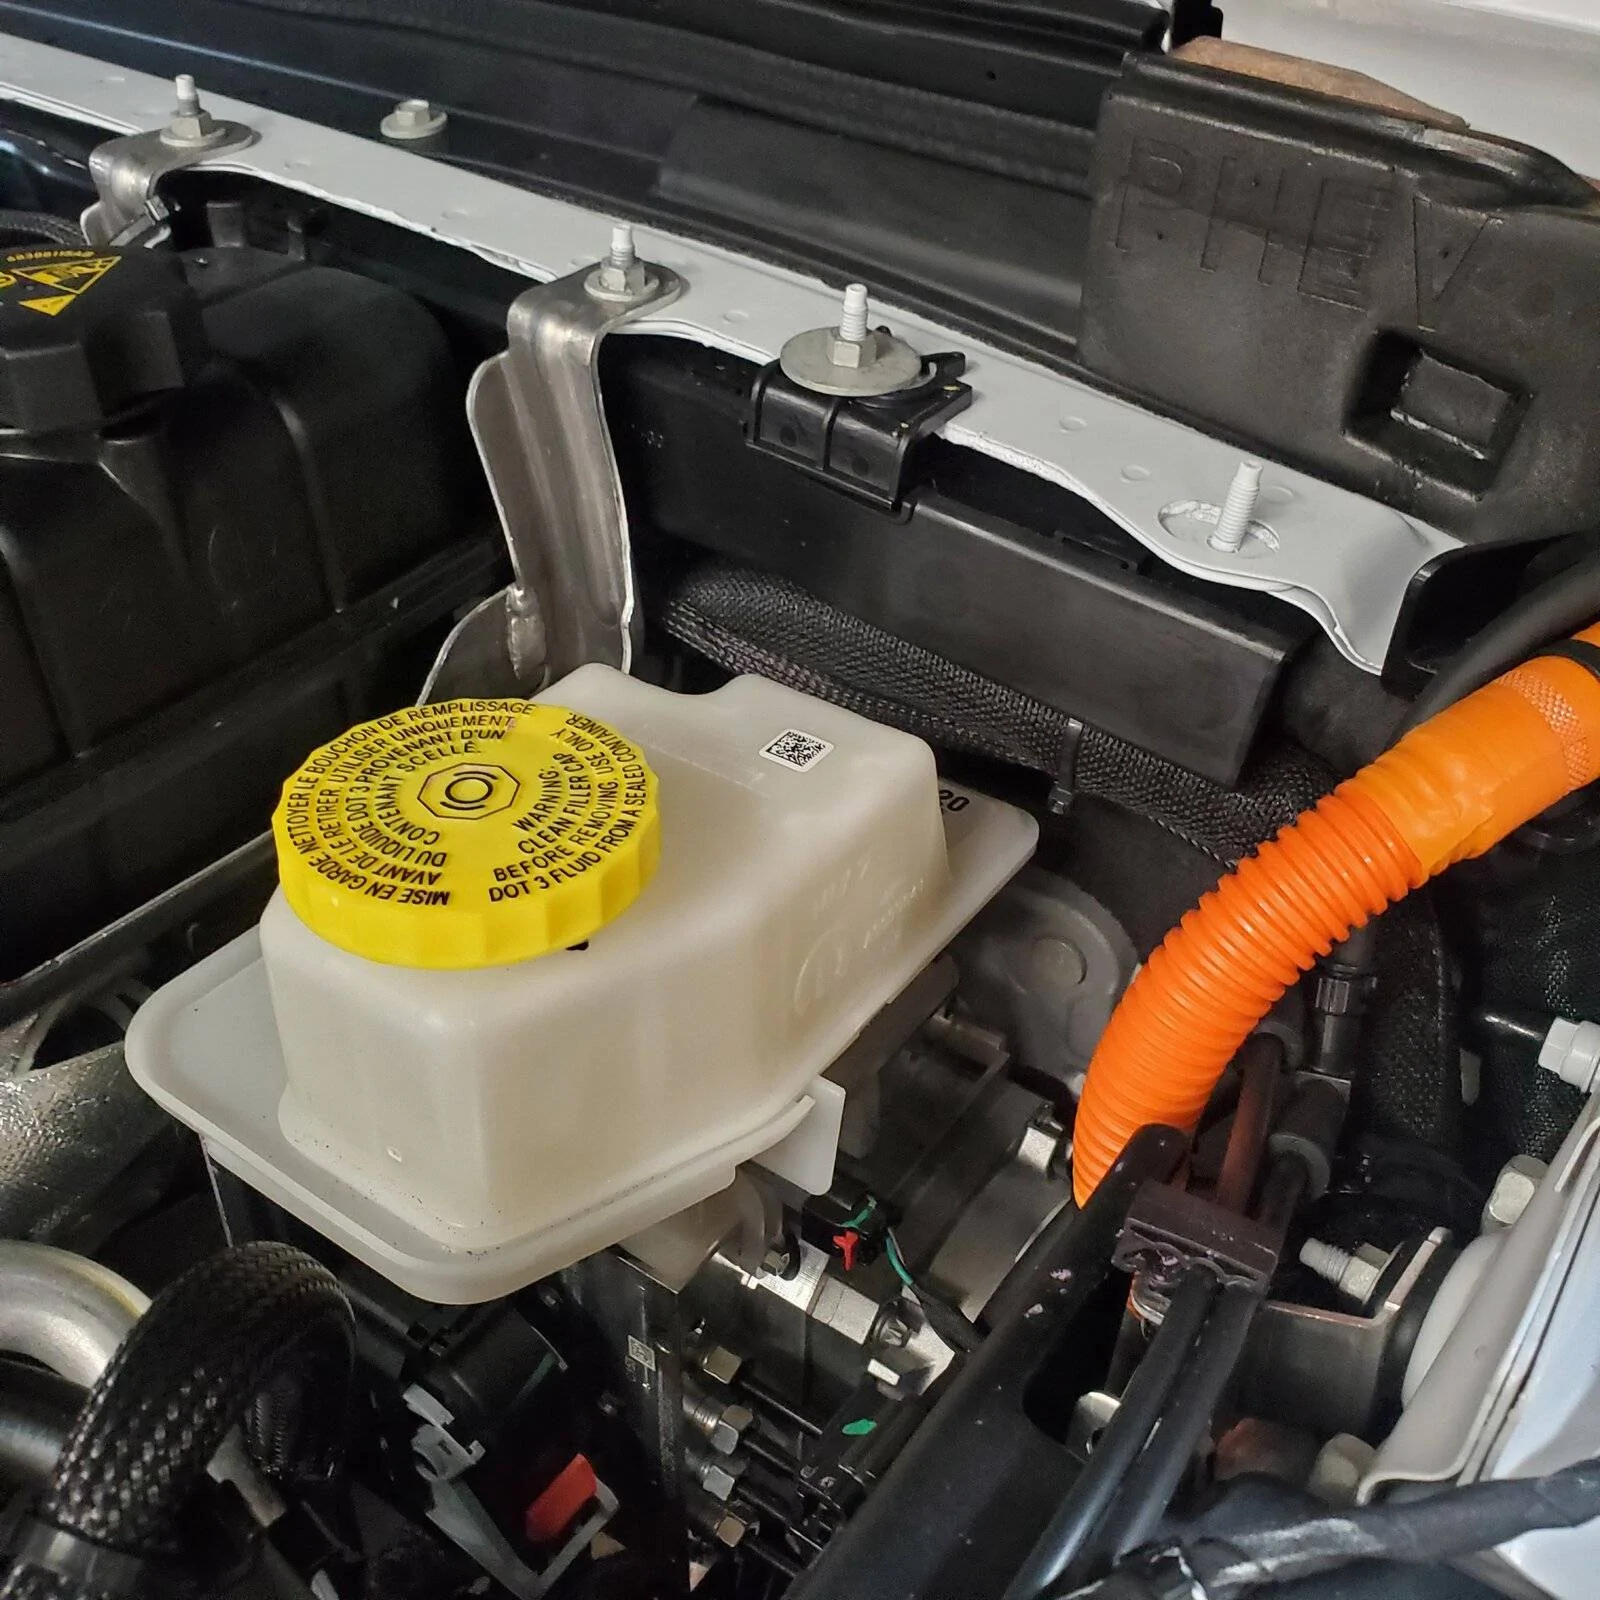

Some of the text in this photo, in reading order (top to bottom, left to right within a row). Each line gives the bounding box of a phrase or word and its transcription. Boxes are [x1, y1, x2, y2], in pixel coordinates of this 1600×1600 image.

[1113, 135, 1505, 333] PHEV
[389, 714, 516, 742] UNIQUEMENT
[549, 728, 595, 752] ONLY
[327, 738, 393, 783] UTILISER
[584, 751, 615, 776] USE
[286, 700, 536, 906] MISE EN GARDE: NETTOYER LE BOUCHON DE REMPLISSAGE
[344, 729, 506, 868] DU LIQUIDE DOT 3 PROVENANT D'UN
[374, 775, 440, 846] CONTENANT
[488, 712, 647, 903] DOT 3 FLUID FROM A SEALED CONTAINER.
[511, 765, 562, 832] WARNING:
[517, 752, 592, 855] CLEAN FILLER CAP
[328, 837, 359, 856] LE
[346, 851, 379, 870] DE
[493, 844, 575, 882] BEFORE
[371, 862, 443, 886] AVANT
